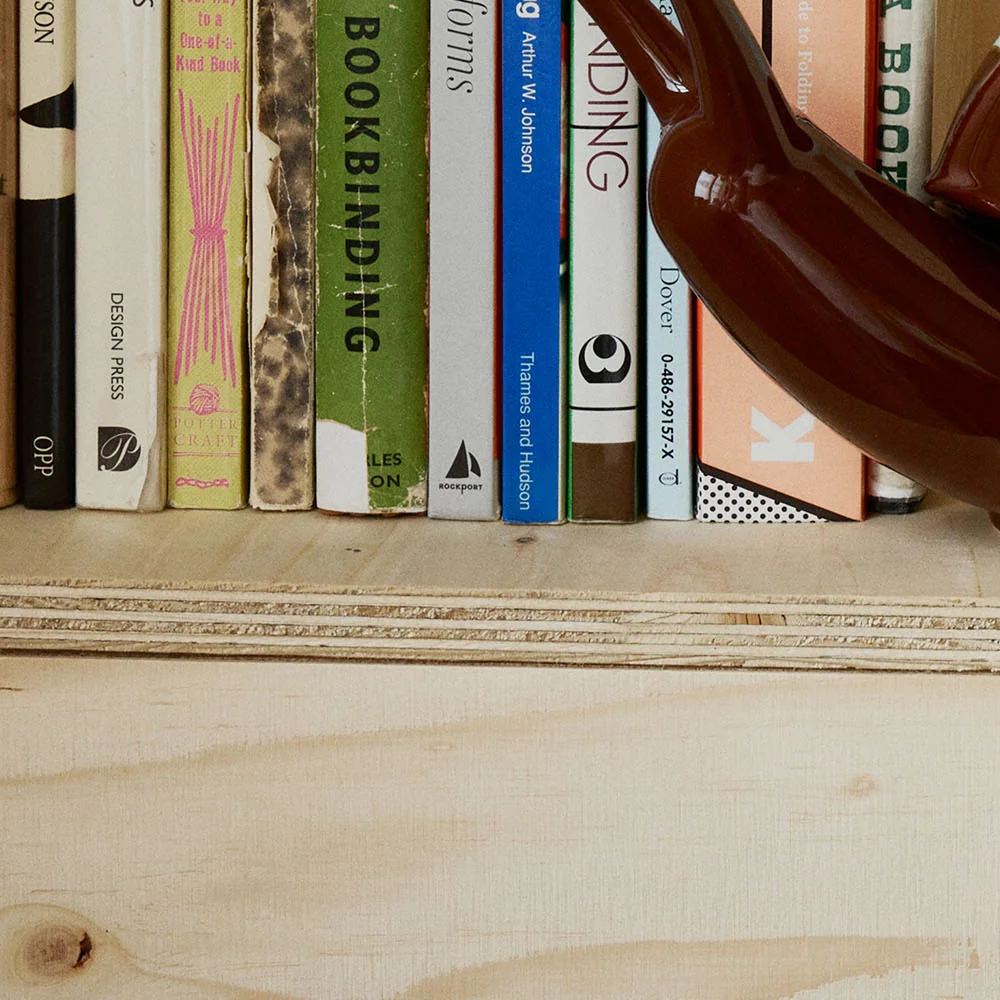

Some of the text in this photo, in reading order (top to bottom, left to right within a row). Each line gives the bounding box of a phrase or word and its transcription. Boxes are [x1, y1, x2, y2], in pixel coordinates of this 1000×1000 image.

[198, 11, 222, 27] to a
[798, 27, 811, 44] to
[180, 32, 237, 49] One-of-a-
[176, 55, 240, 72] Kind Book
[521, 32, 536, 173] Arthur W. Johnson
[344, 16, 381, 353] BOOKBINDING
[660, 266, 680, 334] Dover
[111, 293, 124, 400] DESIGN PRESS
[661, 355, 673, 458] 0-486-29157-X
[174, 433, 237, 448] CRAFT
[519, 352, 535, 510] Thames and Hudson
[34, 436, 53, 476] OPP
[367, 453, 402, 467] LES
